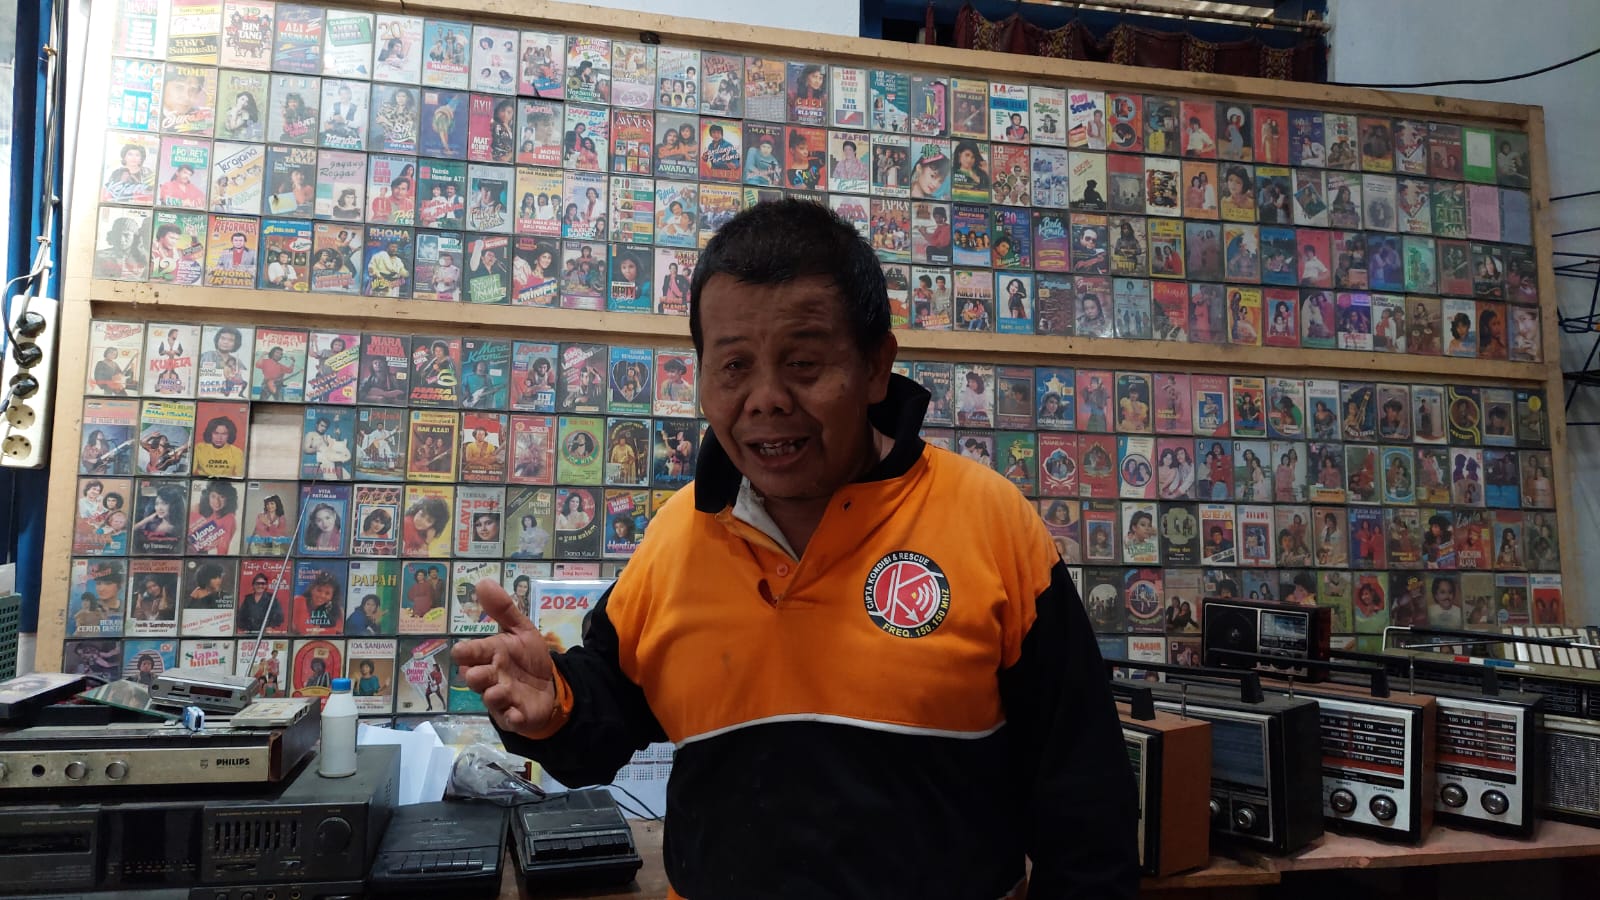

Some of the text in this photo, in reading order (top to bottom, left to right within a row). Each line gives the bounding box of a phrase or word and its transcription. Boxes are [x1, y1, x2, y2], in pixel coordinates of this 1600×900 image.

[242, 22, 259, 31] BIN
[285, 22, 303, 32] ALI
[238, 30, 262, 40] TANG
[993, 85, 1006, 93] 14
[568, 109, 605, 117] DANGDUT
[369, 228, 409, 238] RHOMA
[371, 336, 401, 346] MARA
[192, 524, 215, 539] Yana
[458, 501, 469, 552] MELAYU
[351, 574, 397, 587] PAPAH
[865, 585, 873, 609] CIPTA
[899, 552, 930, 566] RESCUE
[540, 596, 589, 610] 2024
[311, 610, 327, 618] LIA
[882, 623, 913, 637] FREQ.
[940, 588, 949, 609] MHZ
[481, 624, 495, 632] YOU
[216, 758, 250, 767] PHILIPS
